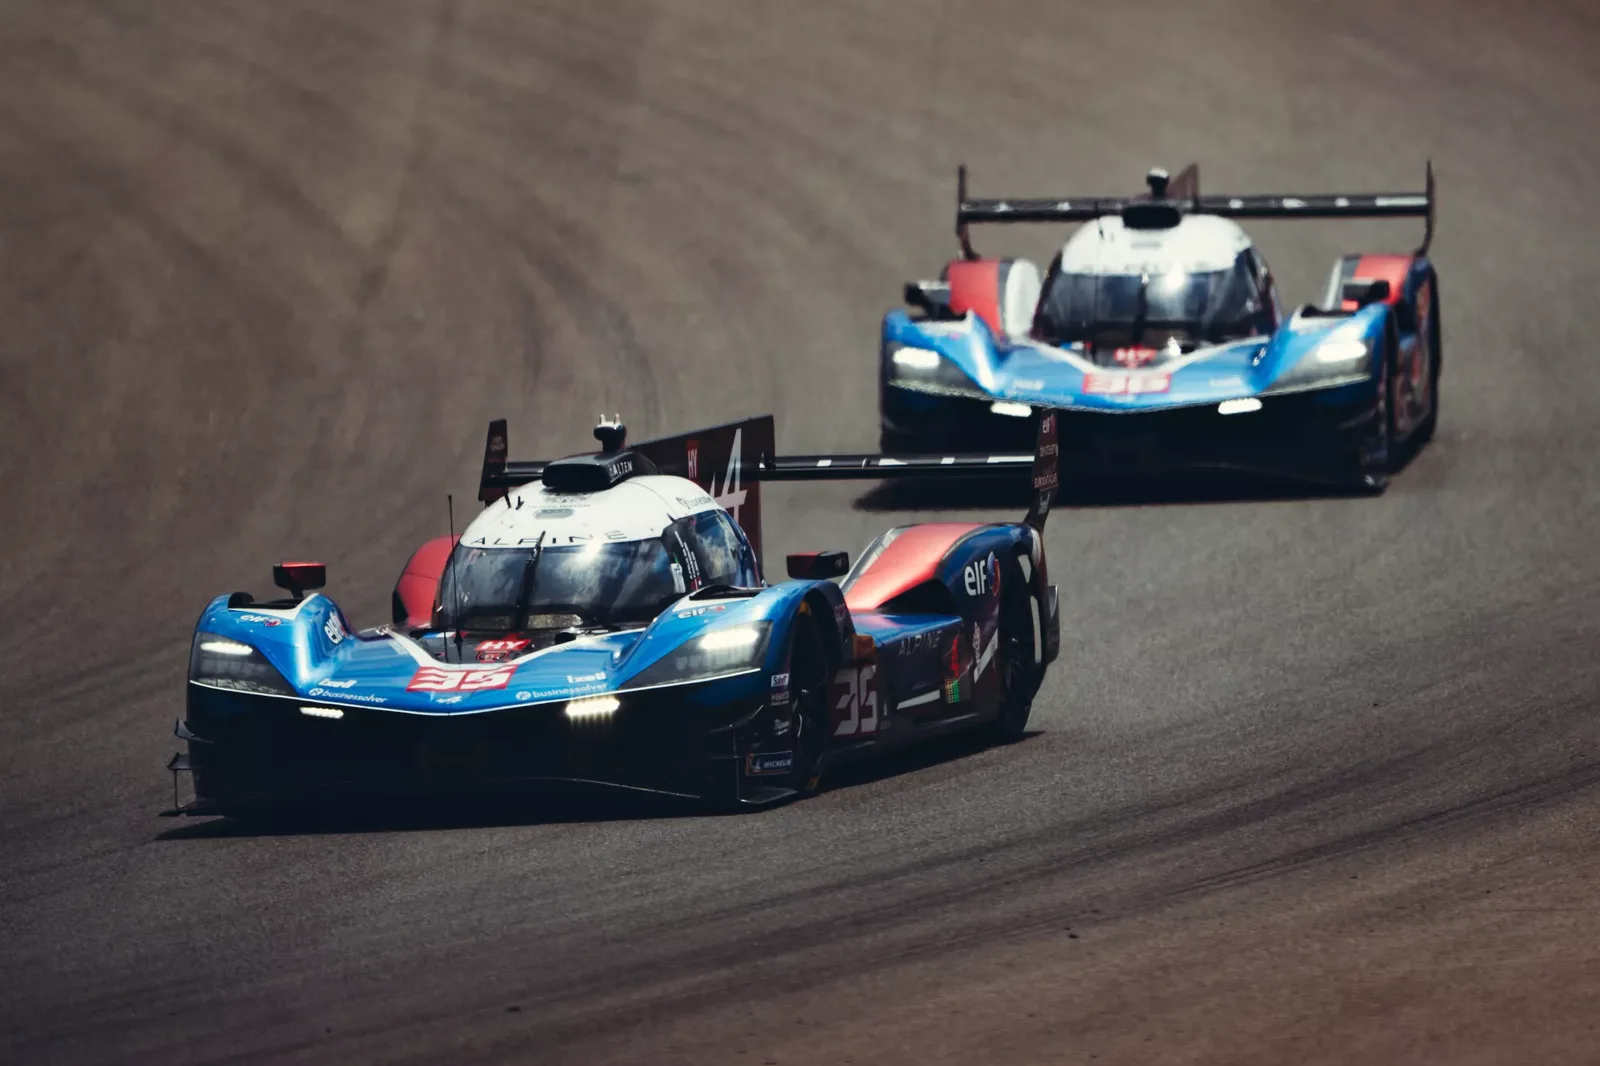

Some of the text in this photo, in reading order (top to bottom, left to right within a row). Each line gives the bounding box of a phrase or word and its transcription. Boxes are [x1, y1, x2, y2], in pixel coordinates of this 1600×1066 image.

[687, 448, 698, 478] HY
[964, 560, 987, 597] elf
[479, 640, 526, 650] HY
[407, 664, 518, 691] 35
[322, 689, 388, 704] businessolver
[532, 682, 608, 699] businessolver
[832, 664, 879, 736] 35
[763, 759, 792, 769] MICHELIN
